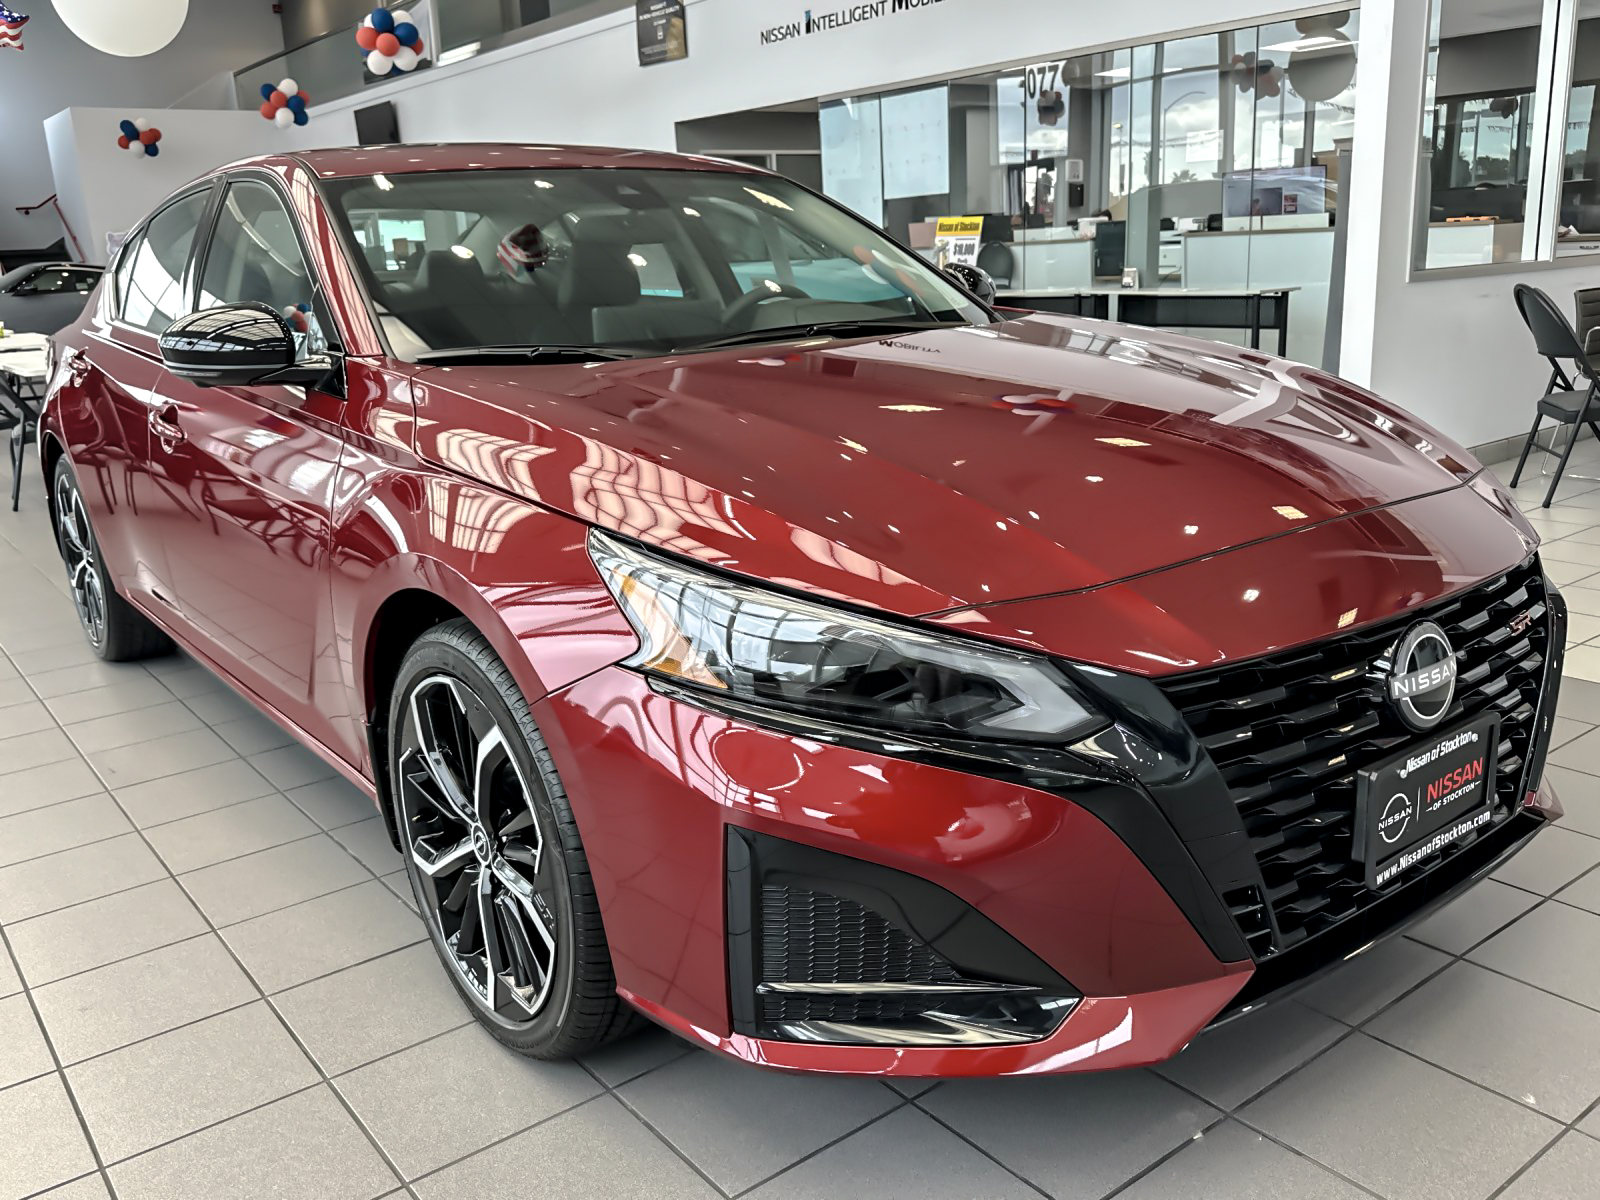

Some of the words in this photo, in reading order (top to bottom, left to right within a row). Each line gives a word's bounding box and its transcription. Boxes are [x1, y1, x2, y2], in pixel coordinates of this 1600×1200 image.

[760, 22, 801, 45] NISSAN
[804, 1, 888, 34] INTELLIGENT
[1393, 660, 1457, 696] NISSAN
[1406, 753, 1430, 773] Nissan
[1431, 744, 1441, 760] of
[1440, 731, 1473, 757] Stockton
[1426, 757, 1484, 803] NISSAN
[1433, 800, 1442, 811] OF
[1442, 781, 1475, 806] STOCKTON
[1378, 806, 1413, 831] NISSAN
[1376, 810, 1491, 885] www.NissanofStockton.com
